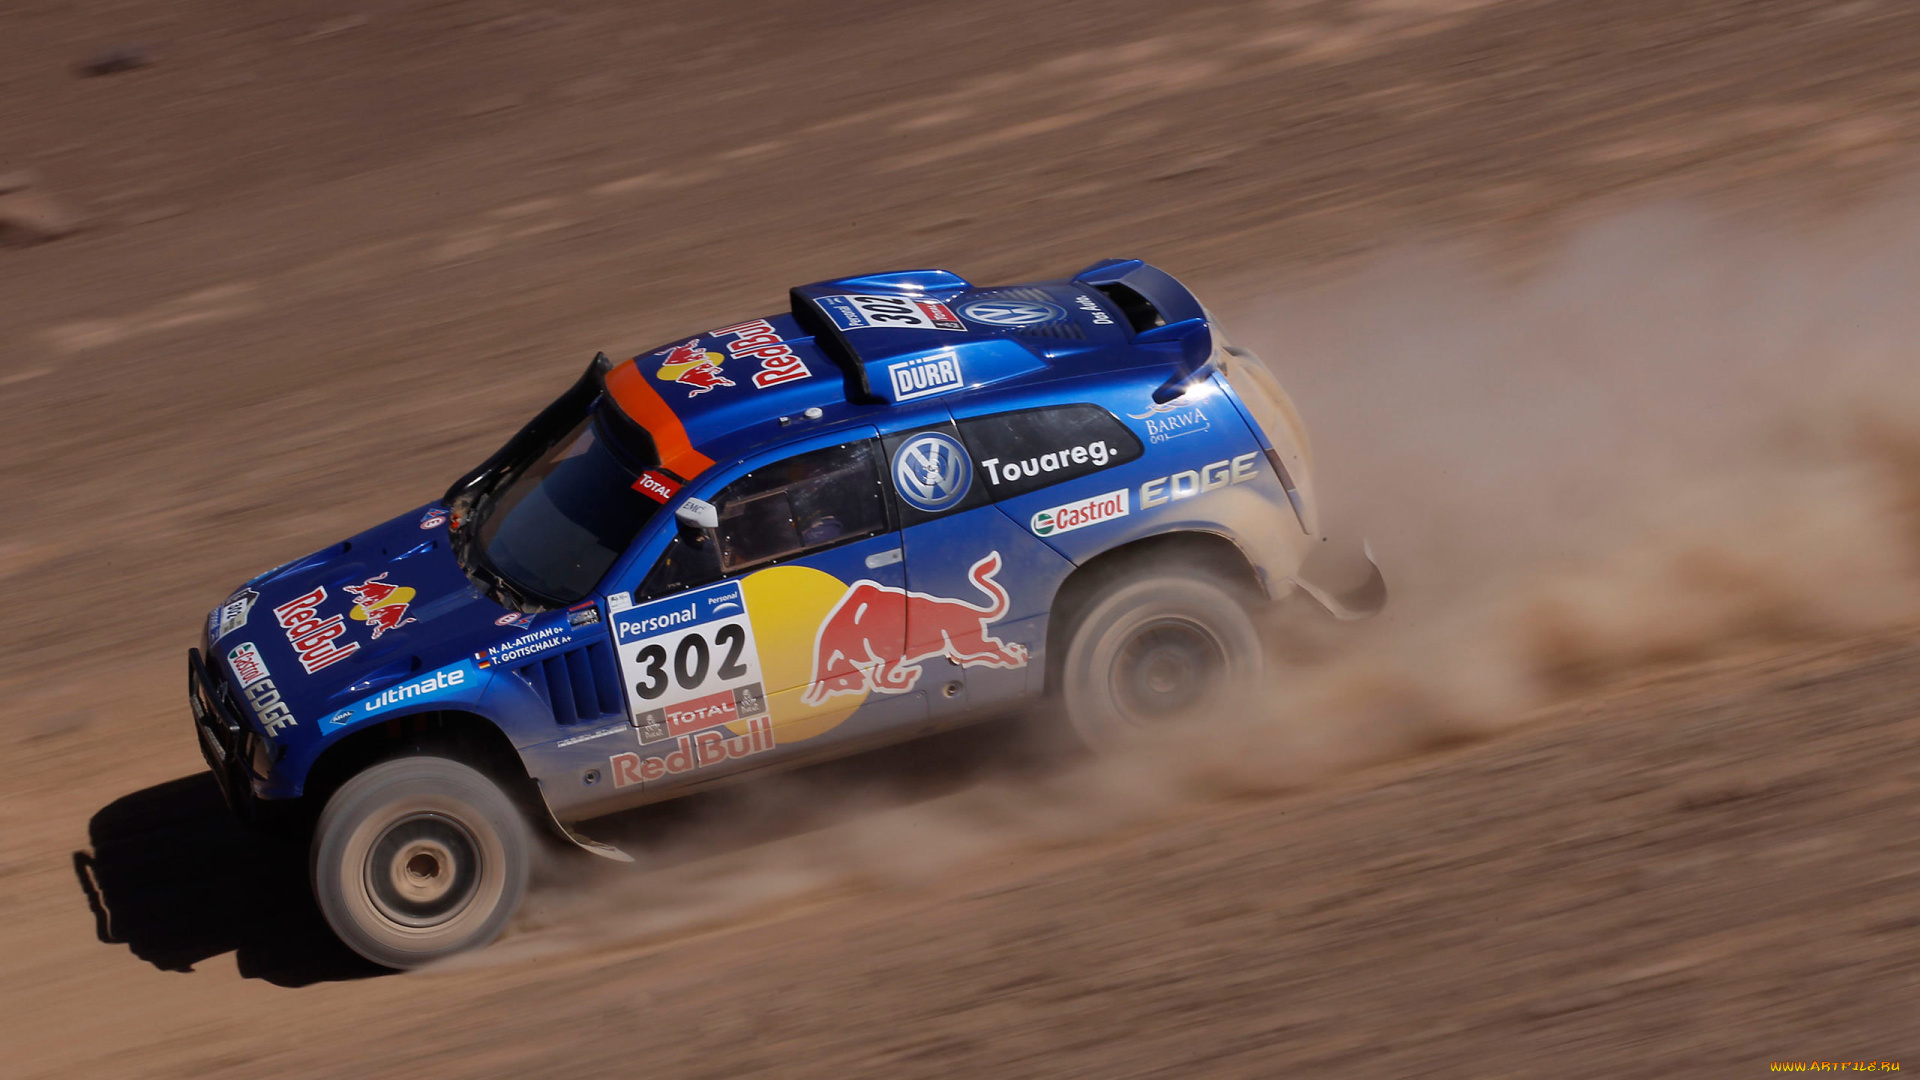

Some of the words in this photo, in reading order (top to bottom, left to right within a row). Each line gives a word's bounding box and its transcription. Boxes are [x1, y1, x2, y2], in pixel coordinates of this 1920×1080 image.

[854, 296, 922, 325] 302
[1091, 312, 1115, 325] Das
[708, 318, 784, 353] Bull
[730, 343, 813, 390] Red
[896, 358, 957, 393] DÜRR
[1145, 407, 1209, 436] BARWA
[981, 440, 1118, 486] Touareg.
[1138, 450, 1260, 511] EDGE
[638, 473, 672, 499] TOTAL
[1055, 494, 1124, 531] Castrol
[273, 585, 345, 643] Red
[708, 591, 739, 605] Personal
[619, 603, 697, 638] Personal
[291, 620, 362, 676] Bull
[488, 646, 500, 655] N.
[501, 627, 554, 651] AL-ATTIYAH
[491, 656, 502, 665] T.
[501, 637, 561, 662] GOTTSCHALK
[233, 651, 265, 685] Castrol
[635, 623, 748, 700] 302
[243, 678, 299, 738] EDGE
[365, 669, 465, 713] ultimate
[332, 710, 352, 722] ARAL
[667, 702, 736, 726] TOTAL
[610, 735, 695, 789] Red
[694, 714, 776, 769] Bull
